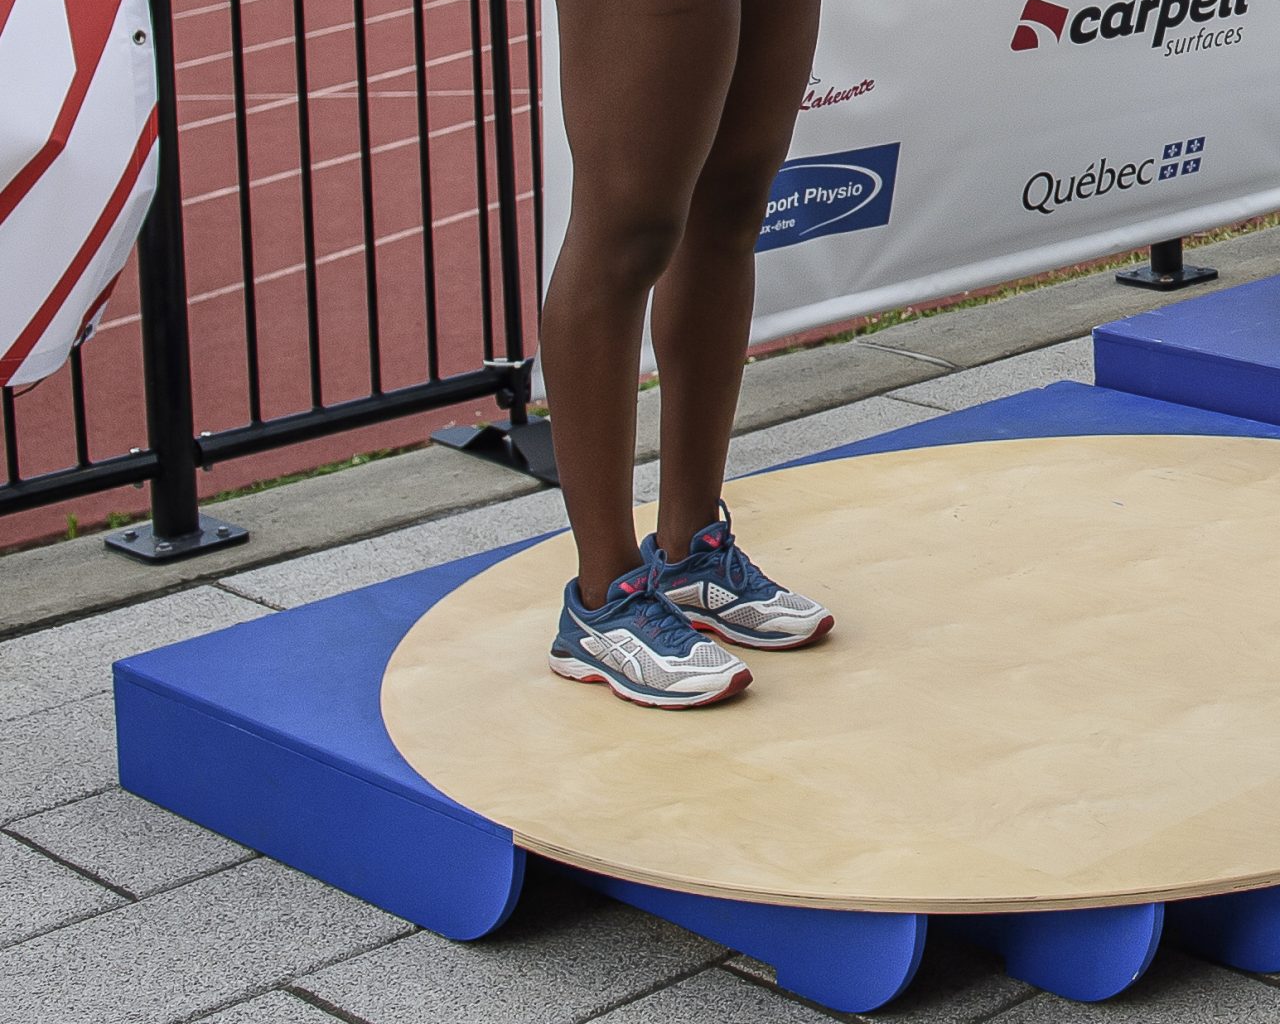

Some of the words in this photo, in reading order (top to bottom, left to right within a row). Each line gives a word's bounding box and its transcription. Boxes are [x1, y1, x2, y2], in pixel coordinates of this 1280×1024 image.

[1164, 26, 1244, 57] surfaces
[765, 191, 799, 217] port
[804, 182, 863, 204] Physio
[1022, 157, 1154, 214] Québec
